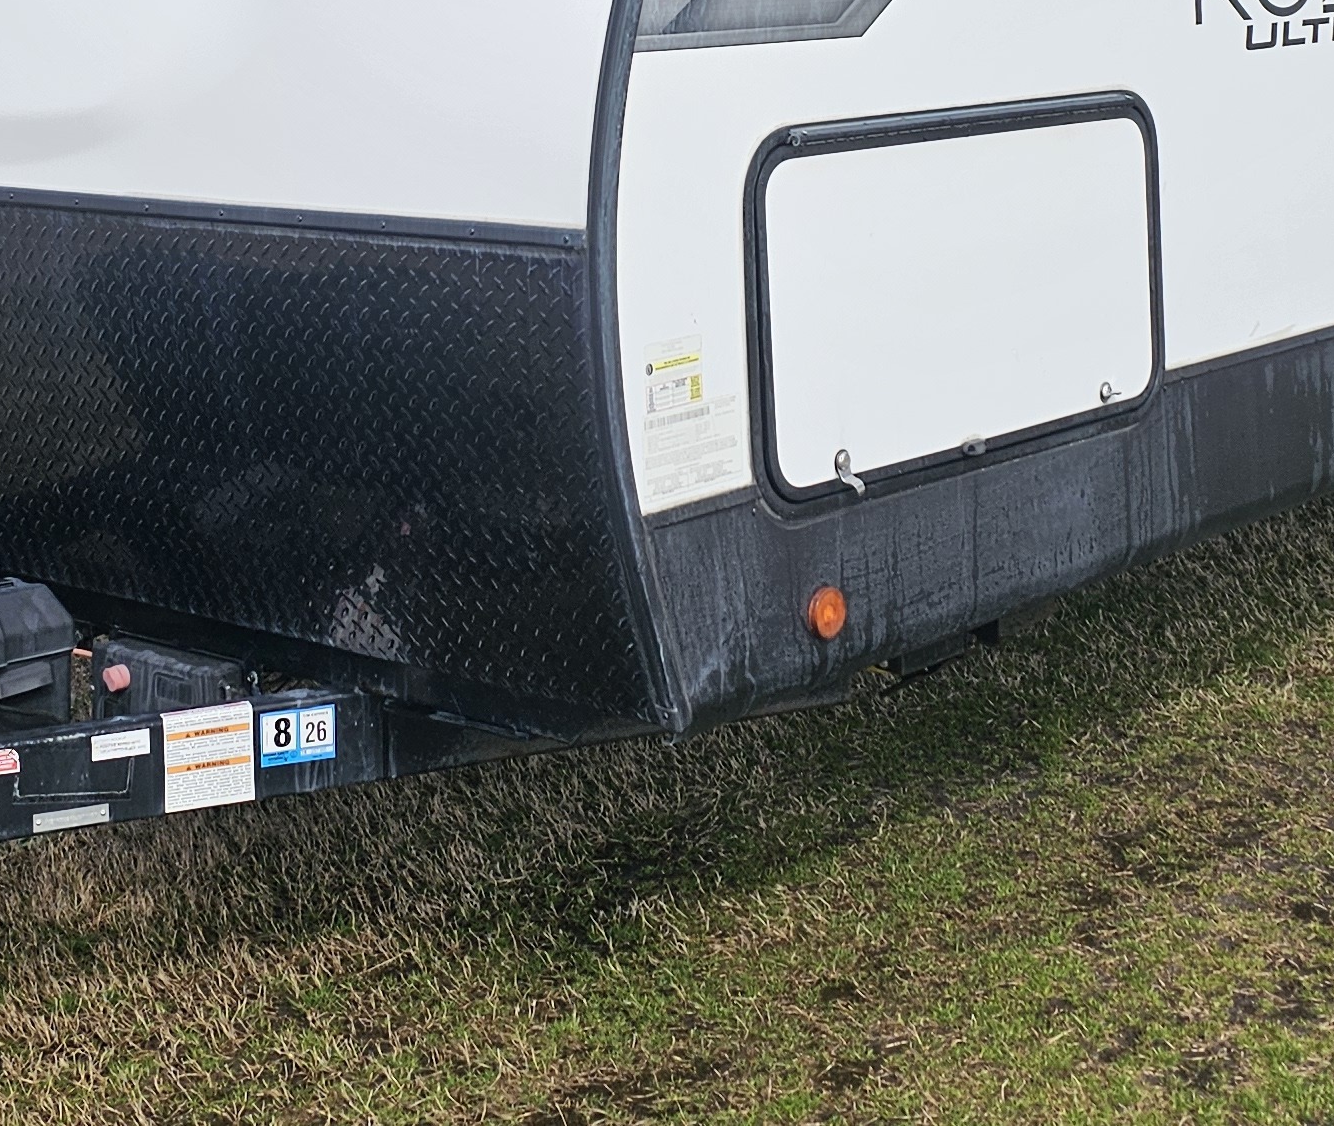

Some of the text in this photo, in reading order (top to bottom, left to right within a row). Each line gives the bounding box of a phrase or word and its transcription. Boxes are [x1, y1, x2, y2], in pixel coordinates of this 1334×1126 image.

[194, 727, 229, 737] WARNING
[273, 717, 292, 747] 8
[305, 720, 327, 743] 26
[194, 759, 230, 769] WARNING
